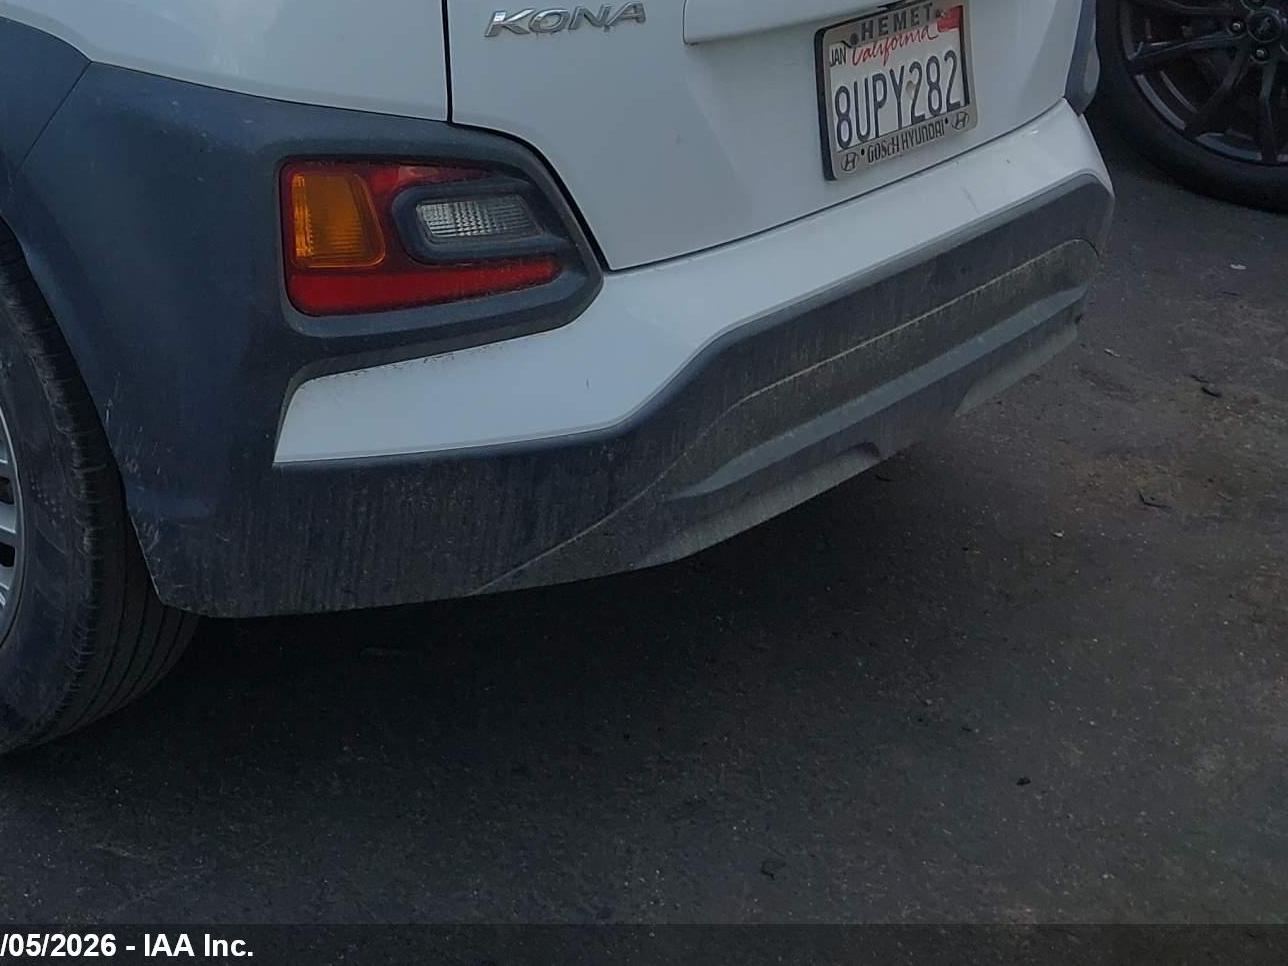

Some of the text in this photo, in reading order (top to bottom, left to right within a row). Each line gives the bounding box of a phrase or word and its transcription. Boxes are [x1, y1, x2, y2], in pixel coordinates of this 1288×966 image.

[484, 0, 647, 38] KONA
[861, 2, 934, 42] HEMET
[829, 24, 939, 68] JAN California
[833, 49, 961, 150] 8UPY282
[900, 119, 945, 151] HYUNDAI
